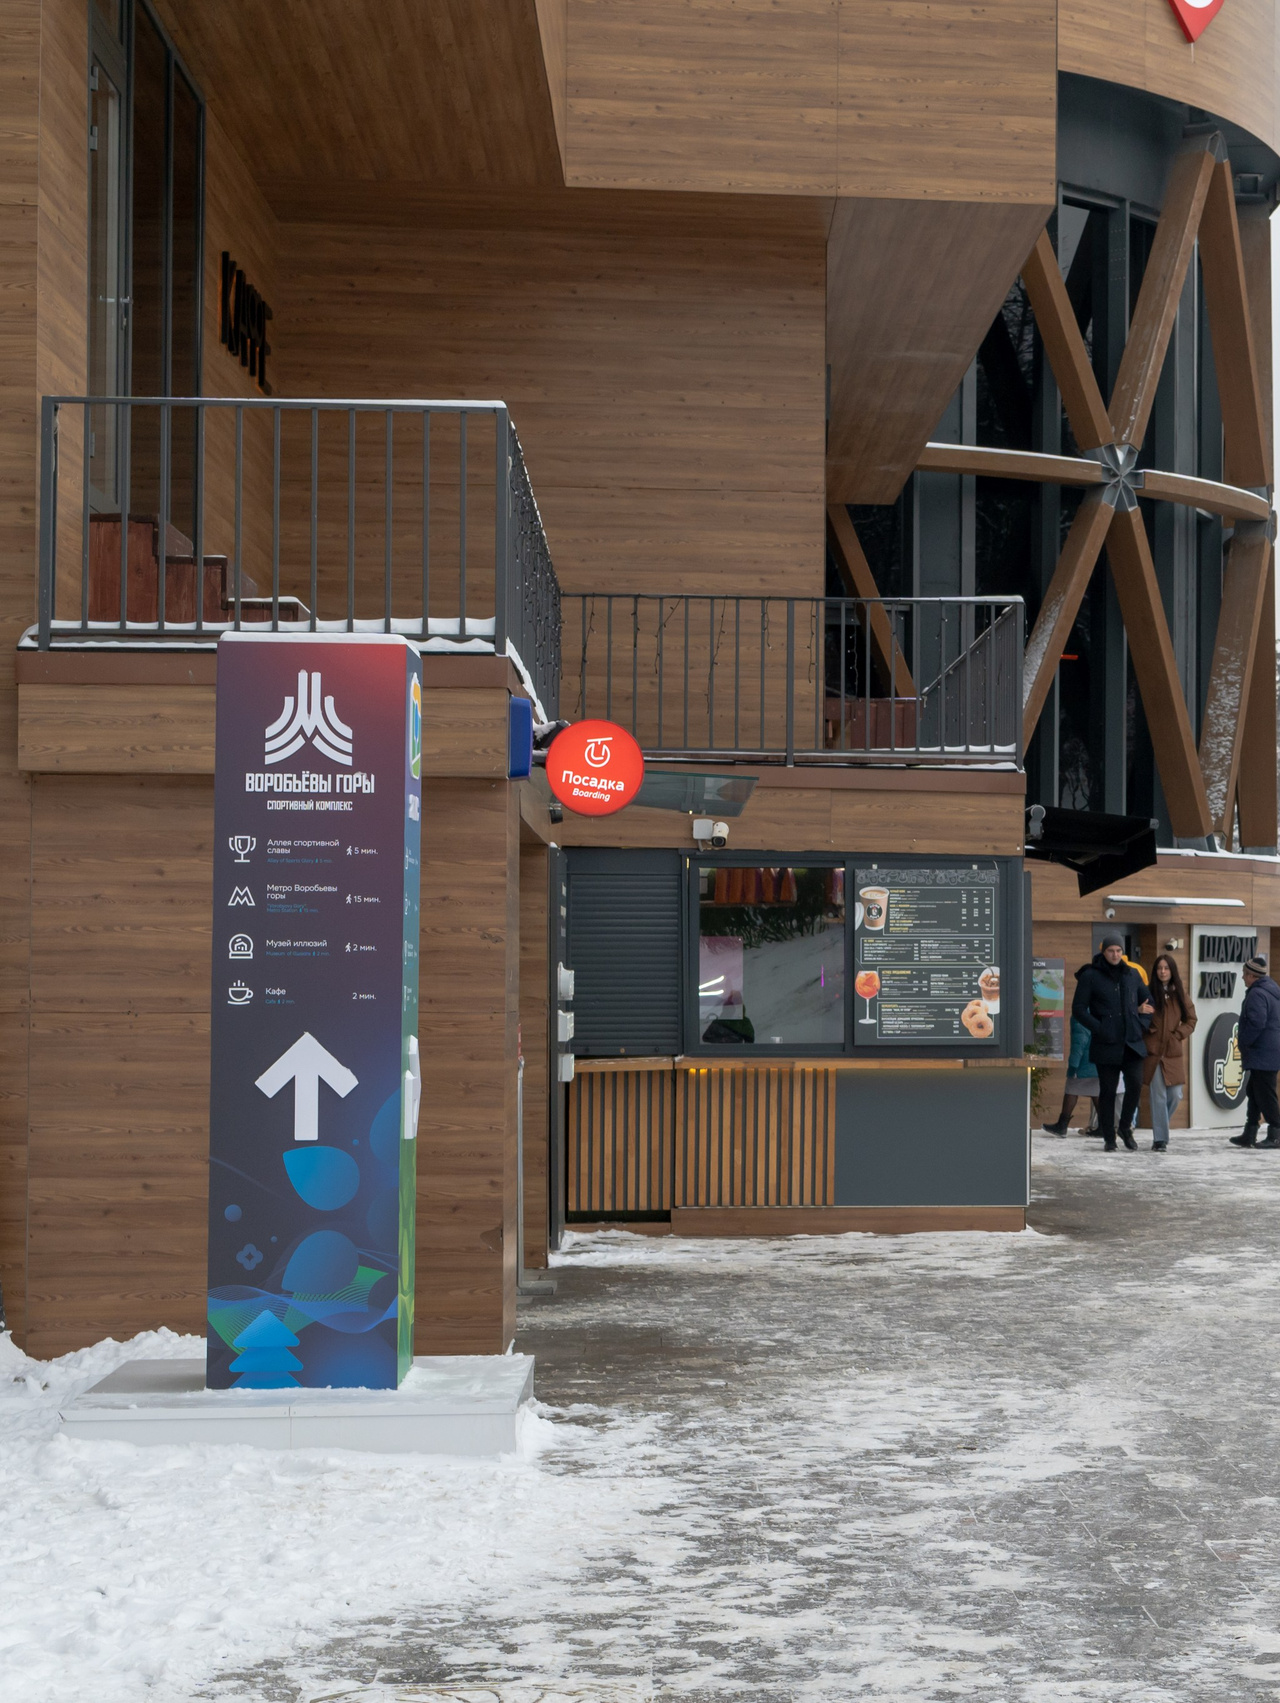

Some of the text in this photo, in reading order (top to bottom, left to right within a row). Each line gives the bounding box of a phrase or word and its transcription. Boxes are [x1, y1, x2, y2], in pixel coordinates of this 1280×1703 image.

[245, 771, 375, 794] ВОРОБЬЁВЫ ГОРЫ
[562, 770, 625, 791] Посадка
[572, 788, 611, 802] Boarding
[267, 800, 353, 811] СПОРТИВНЫЙ КОМПЛЕКС
[267, 839, 340, 848] Аллея спортивной
[354, 846, 360, 855] 5
[266, 884, 338, 893] Метро Воробьевы
[266, 893, 286, 901] горы
[354, 895, 362, 904] 15
[266, 939, 328, 949] Музей иллюзий
[352, 943, 359, 952] 2
[265, 987, 287, 996] Кафе
[352, 992, 358, 1000] 2
